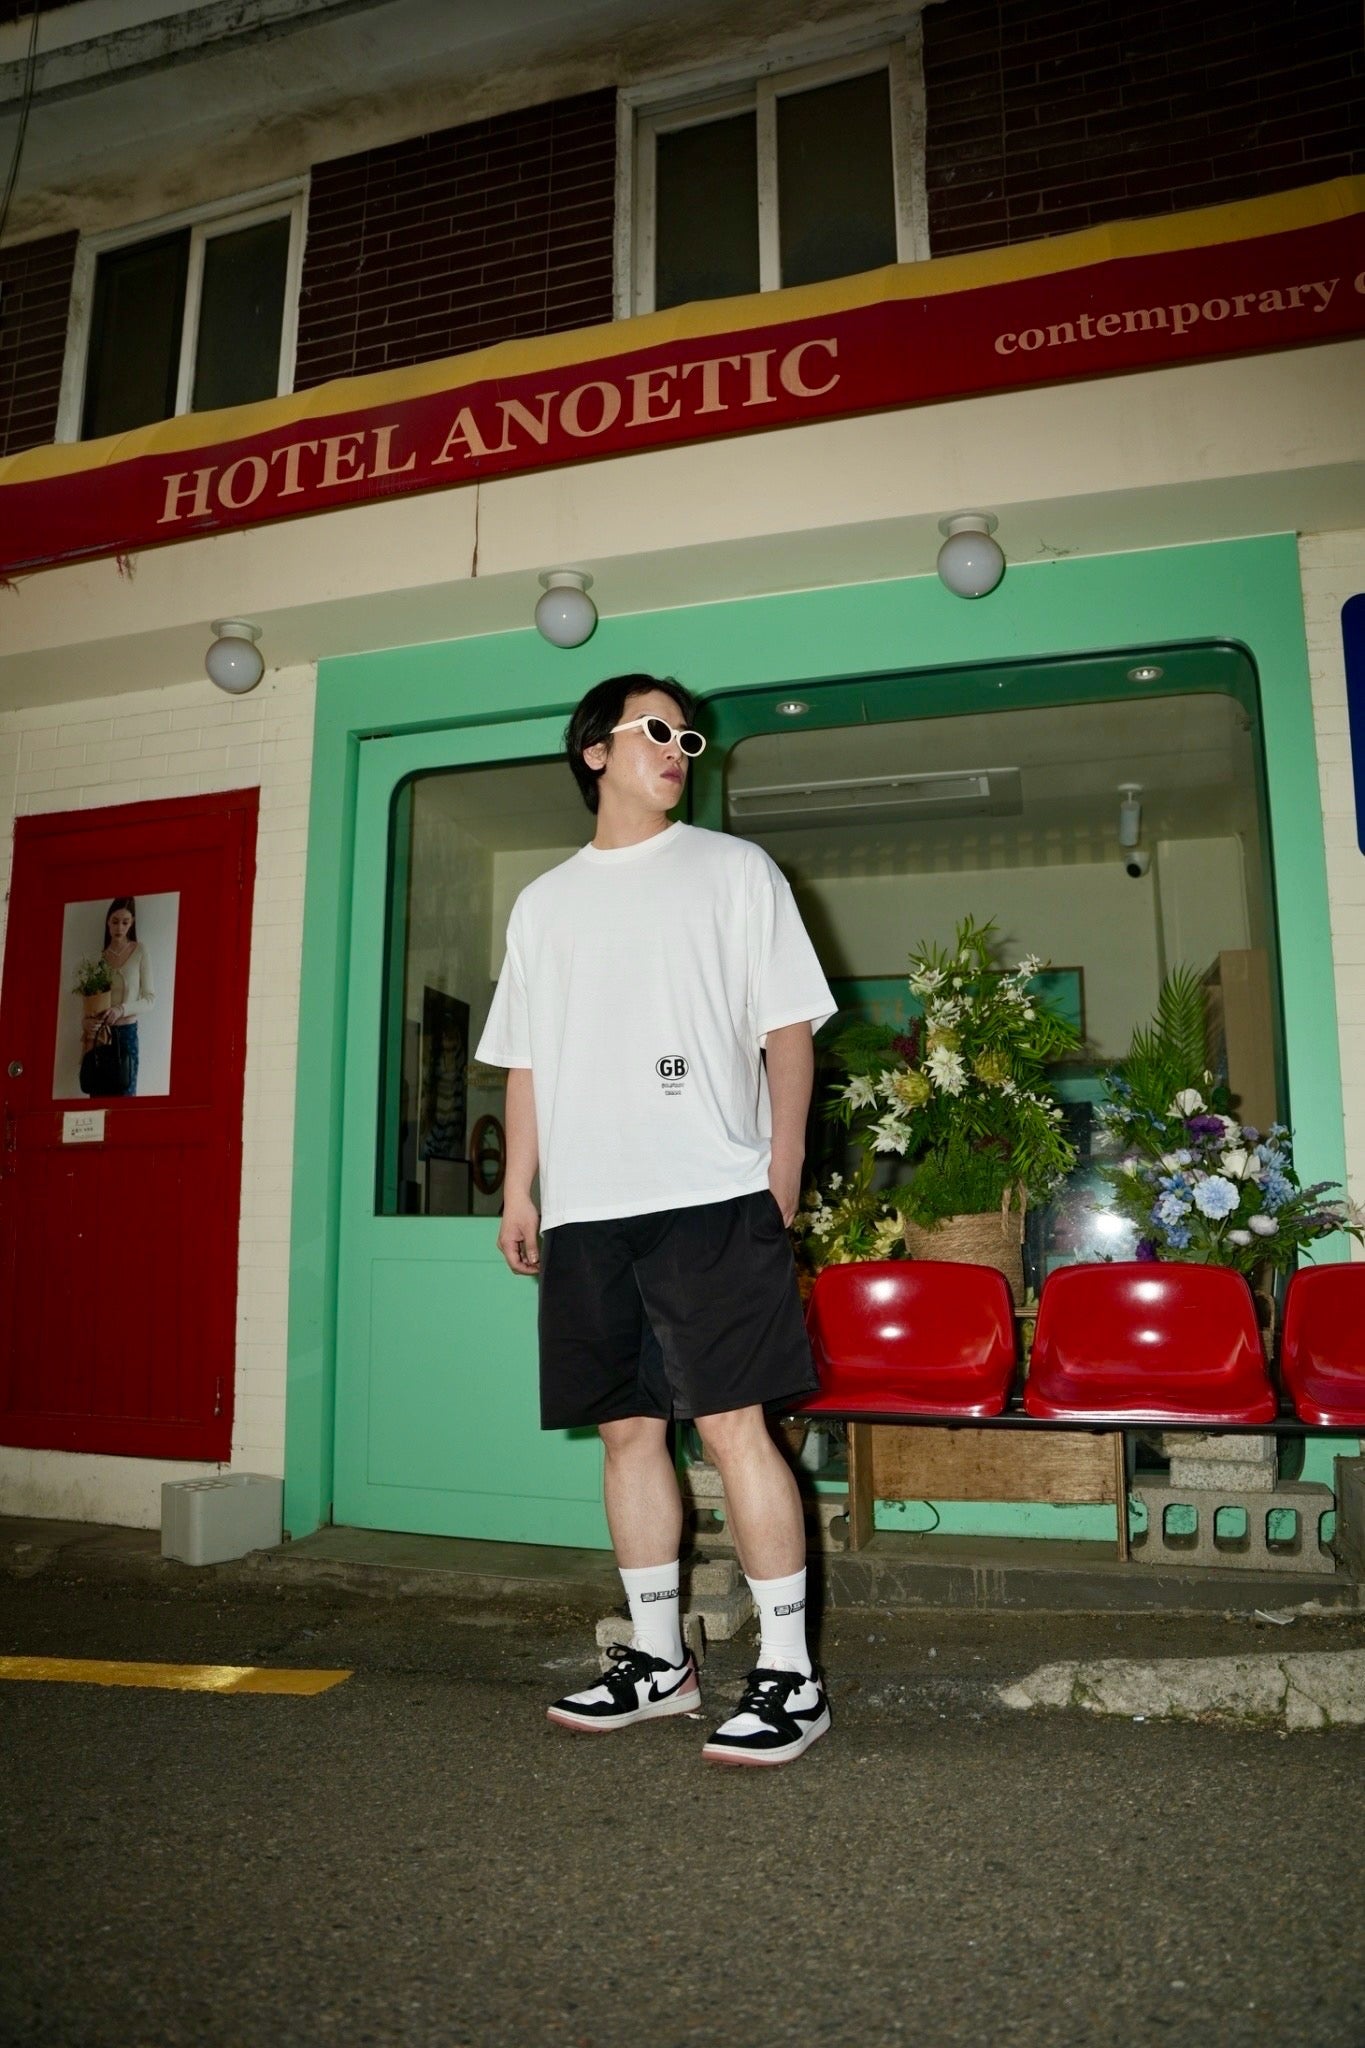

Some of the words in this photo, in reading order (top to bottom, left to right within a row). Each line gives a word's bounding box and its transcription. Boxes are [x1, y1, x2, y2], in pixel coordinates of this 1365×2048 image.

[994, 277, 1341, 356] contemporary
[157, 423, 416, 525] HOTEL
[431, 337, 842, 465] ANOETIC
[659, 1058, 686, 1077] GB
